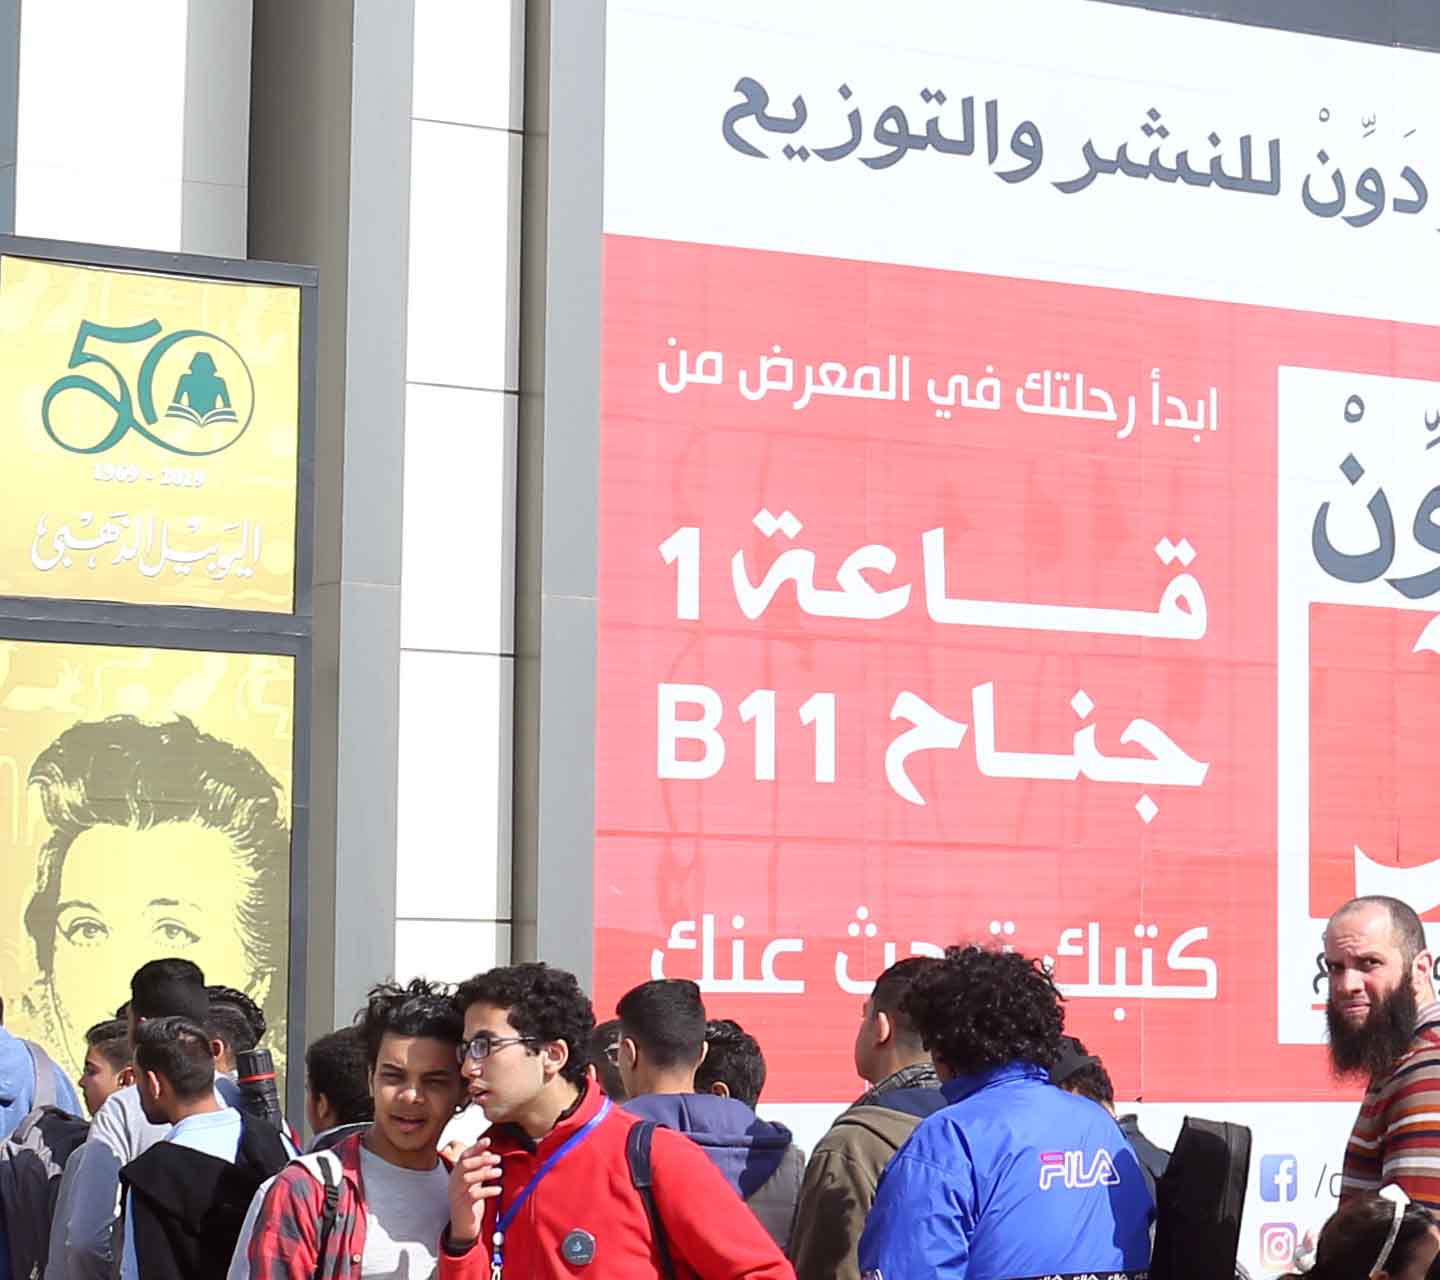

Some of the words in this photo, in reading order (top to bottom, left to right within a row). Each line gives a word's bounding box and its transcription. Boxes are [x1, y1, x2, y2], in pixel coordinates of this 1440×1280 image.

[720, 75, 1044, 184] والتوزيع
[1050, 107, 1282, 195] للنشر
[657, 336, 724, 394] من
[738, 345, 911, 410] المعرض
[927, 365, 1002, 419] في
[1015, 369, 1136, 439] رحلتك
[1151, 367, 1219, 443] ابدأ
[658, 526, 700, 620] 1
[731, 507, 1208, 640] قاعة
[657, 682, 836, 783] B11
[885, 681, 1210, 824] جناح
[650, 912, 805, 993] عنك
[1039, 1148, 1121, 1191] FILA
